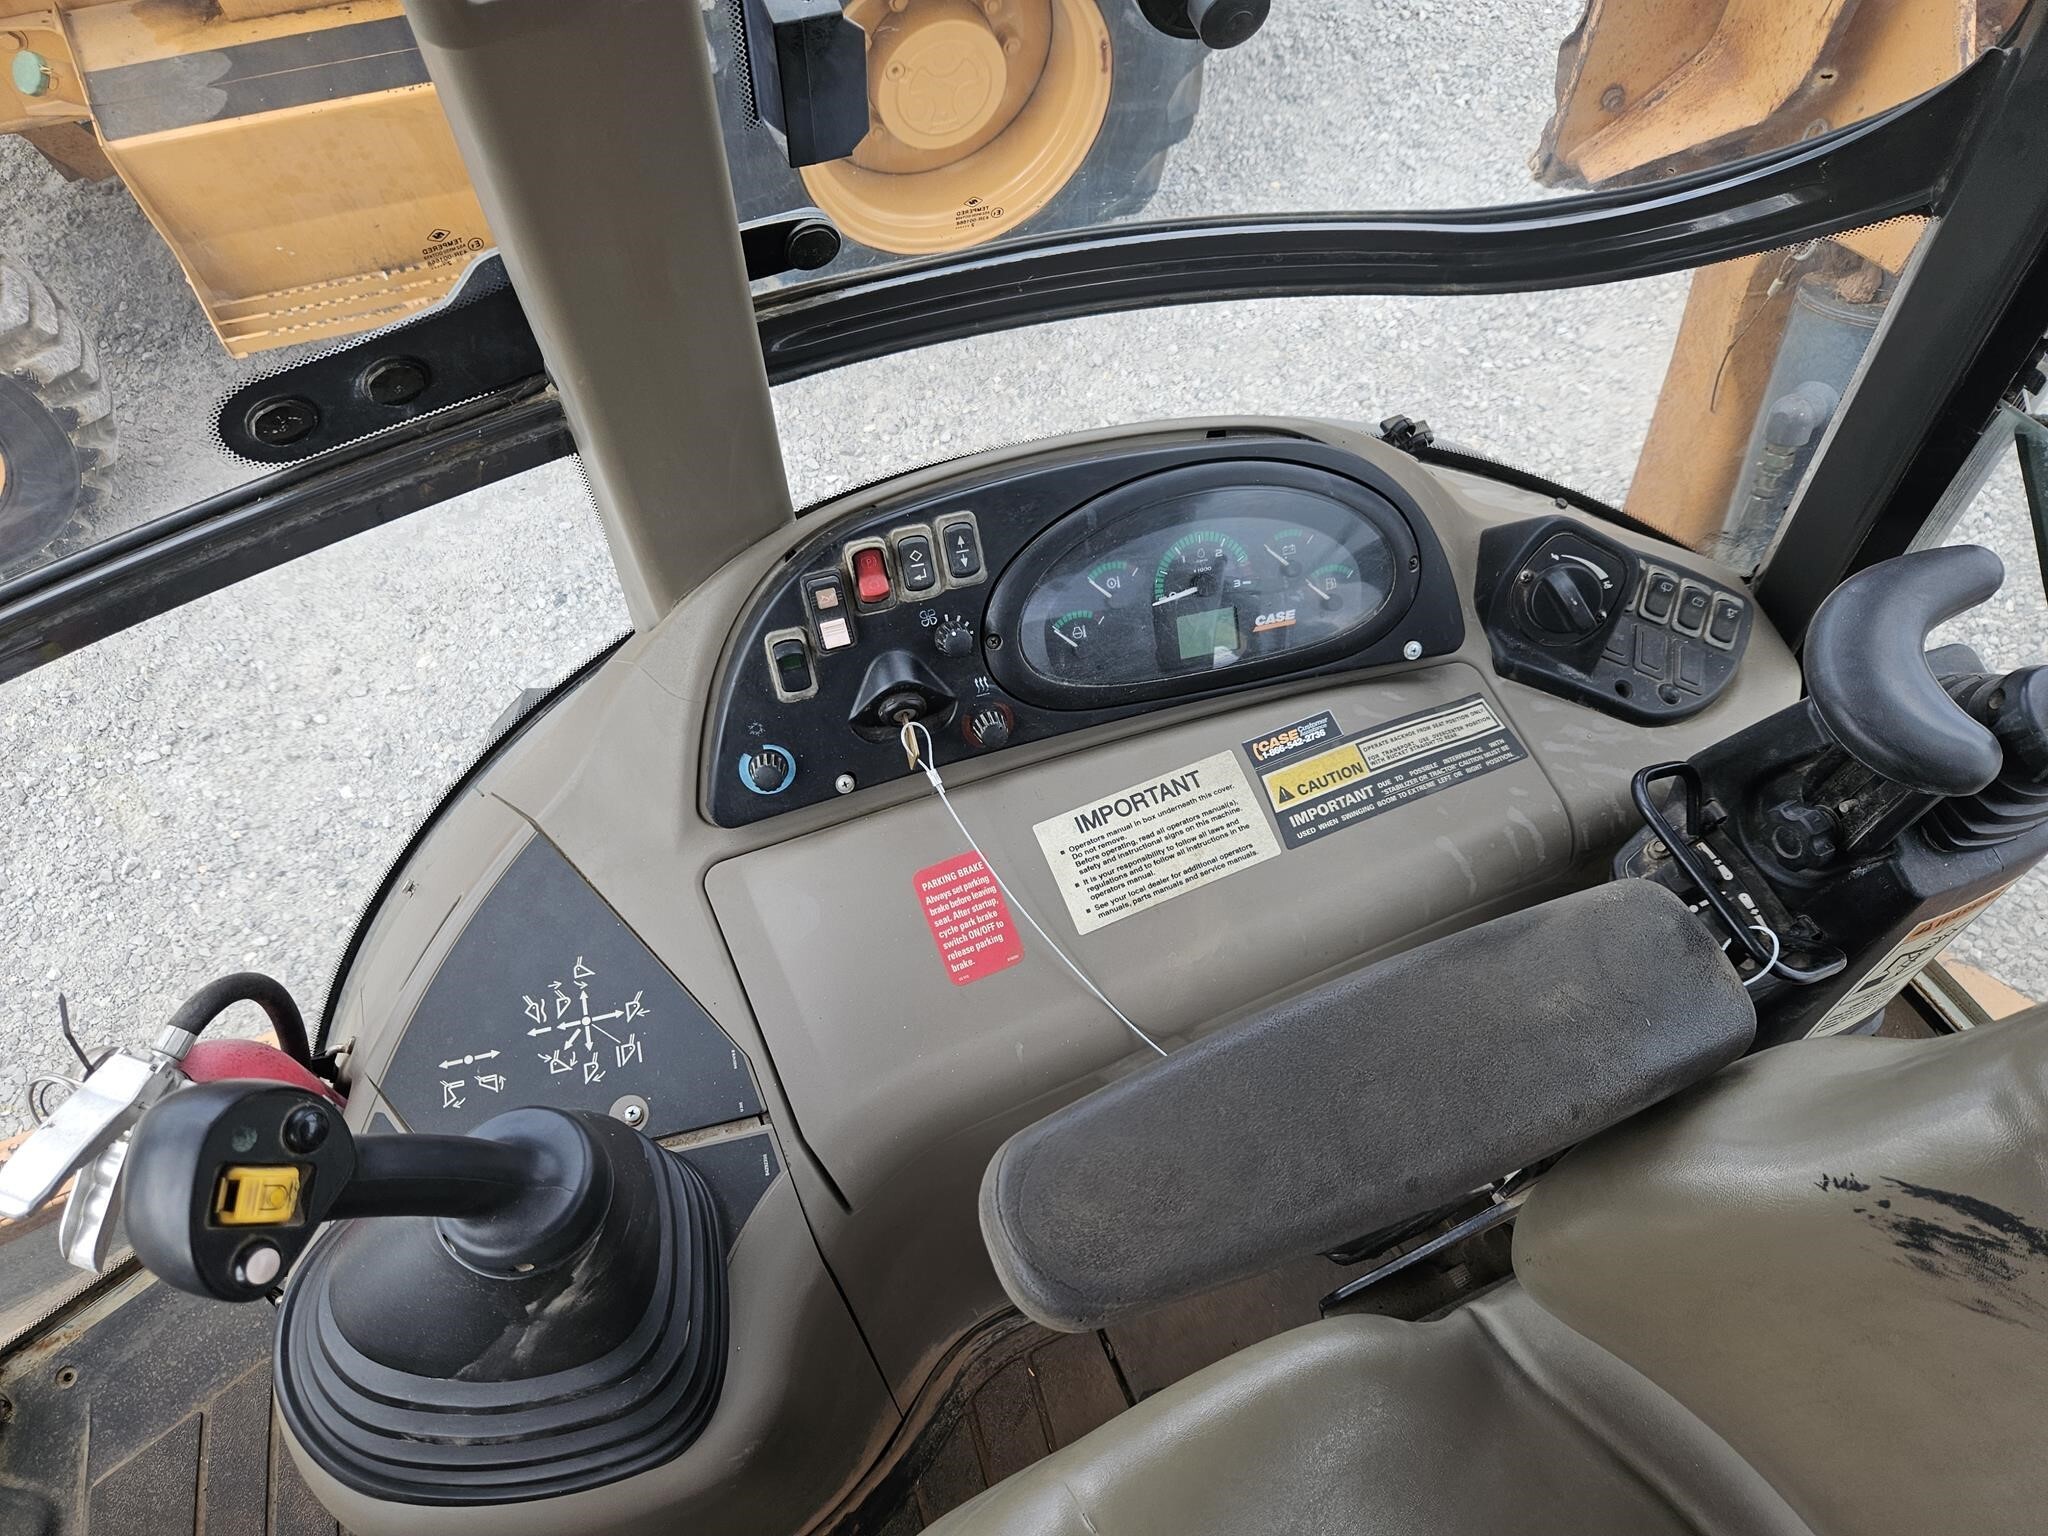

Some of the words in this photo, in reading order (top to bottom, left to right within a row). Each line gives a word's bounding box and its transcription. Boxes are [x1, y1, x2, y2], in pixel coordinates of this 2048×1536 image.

[1215, 549, 1223, 557] 2
[1233, 580, 1240, 588] 3
[1255, 609, 1296, 626] CASE
[1298, 718, 1328, 732] Customer
[1363, 740, 1389, 752] OPERATE
[1390, 731, 1415, 742] BACKHOE
[1445, 714, 1469, 724] POSITION
[1258, 729, 1298, 752] CASE
[1377, 779, 1392, 788] DUE
[1409, 762, 1438, 776] POSSIBLE
[1442, 747, 1483, 764] INTERFERENCE
[1488, 739, 1504, 748] WITH
[1458, 755, 1484, 767] CAUTION
[1483, 748, 1500, 758] MUST
[1297, 762, 1364, 795] CAUTION
[1074, 770, 1201, 834] IMPORTANT
[1289, 785, 1374, 827] IMPORTANT
[1297, 827, 1316, 838] USED
[1318, 818, 1339, 830] WHEN
[1341, 804, 1375, 821] SWINGING
[1376, 795, 1397, 807] BOOM
[1407, 780, 1436, 795] EXTREME
[1437, 774, 1452, 784] LEFT
[1465, 764, 1482, 773] RIGHT
[1068, 835, 1105, 852] Operators
[1106, 822, 1133, 837] manual
[1142, 815, 1156, 823] box
[1157, 798, 1197, 817] underneath
[1214, 784, 1234, 795] cover.
[1075, 855, 1100, 867] Before
[1101, 840, 1138, 857] operating,
[1138, 831, 1155, 842] read
[1166, 814, 1200, 831] operators
[1202, 800, 1238, 817] manual(s),
[1079, 862, 1101, 874] safety
[1103, 855, 1116, 865] and
[1117, 837, 1163, 859] instructional
[1164, 830, 1184, 840] signs
[1196, 820, 1209, 828] this
[1211, 808, 1240, 822] machine.
[1084, 846, 1096, 855] not
[1098, 836, 1127, 849] remove.
[1087, 873, 1128, 892] regulations
[1130, 865, 1143, 875] and
[1153, 854, 1174, 866] follow
[1186, 832, 1228, 852] instructions
[1098, 869, 1114, 880] your
[1116, 849, 1165, 872] responsibility
[1175, 836, 1196, 848] follow
[1208, 826, 1224, 835] laws
[1226, 818, 1239, 828] and
[922, 872, 957, 891] PARKING
[958, 861, 984, 878] BRAKE
[926, 892, 952, 905] Always
[952, 885, 963, 895] set
[964, 876, 990, 892] parking
[1090, 883, 1125, 900] operators
[1126, 870, 1155, 885] manual.
[1094, 902, 1108, 910] See
[1110, 894, 1126, 906] your
[1128, 885, 1146, 897] local
[1148, 877, 1169, 889] dealer
[1183, 856, 1218, 875] additional
[1220, 844, 1253, 860] operators
[1098, 902, 1131, 918] manuals,
[1132, 894, 1152, 906] parts
[1153, 880, 1183, 896] manuals
[1185, 873, 1198, 883] and
[1200, 863, 1226, 877] service
[1227, 851, 1258, 866] manuals.
[929, 902, 950, 916] brake
[950, 895, 971, 908] before
[971, 885, 996, 900] leaving
[939, 926, 958, 939] cycle
[960, 919, 976, 932] park
[977, 910, 998, 922] brake
[943, 934, 968, 949] switch
[969, 922, 996, 939] ON/OFF
[996, 921, 1004, 929] to
[948, 944, 974, 961] release
[976, 934, 1004, 952] parking
[951, 958, 975, 972] brake.
